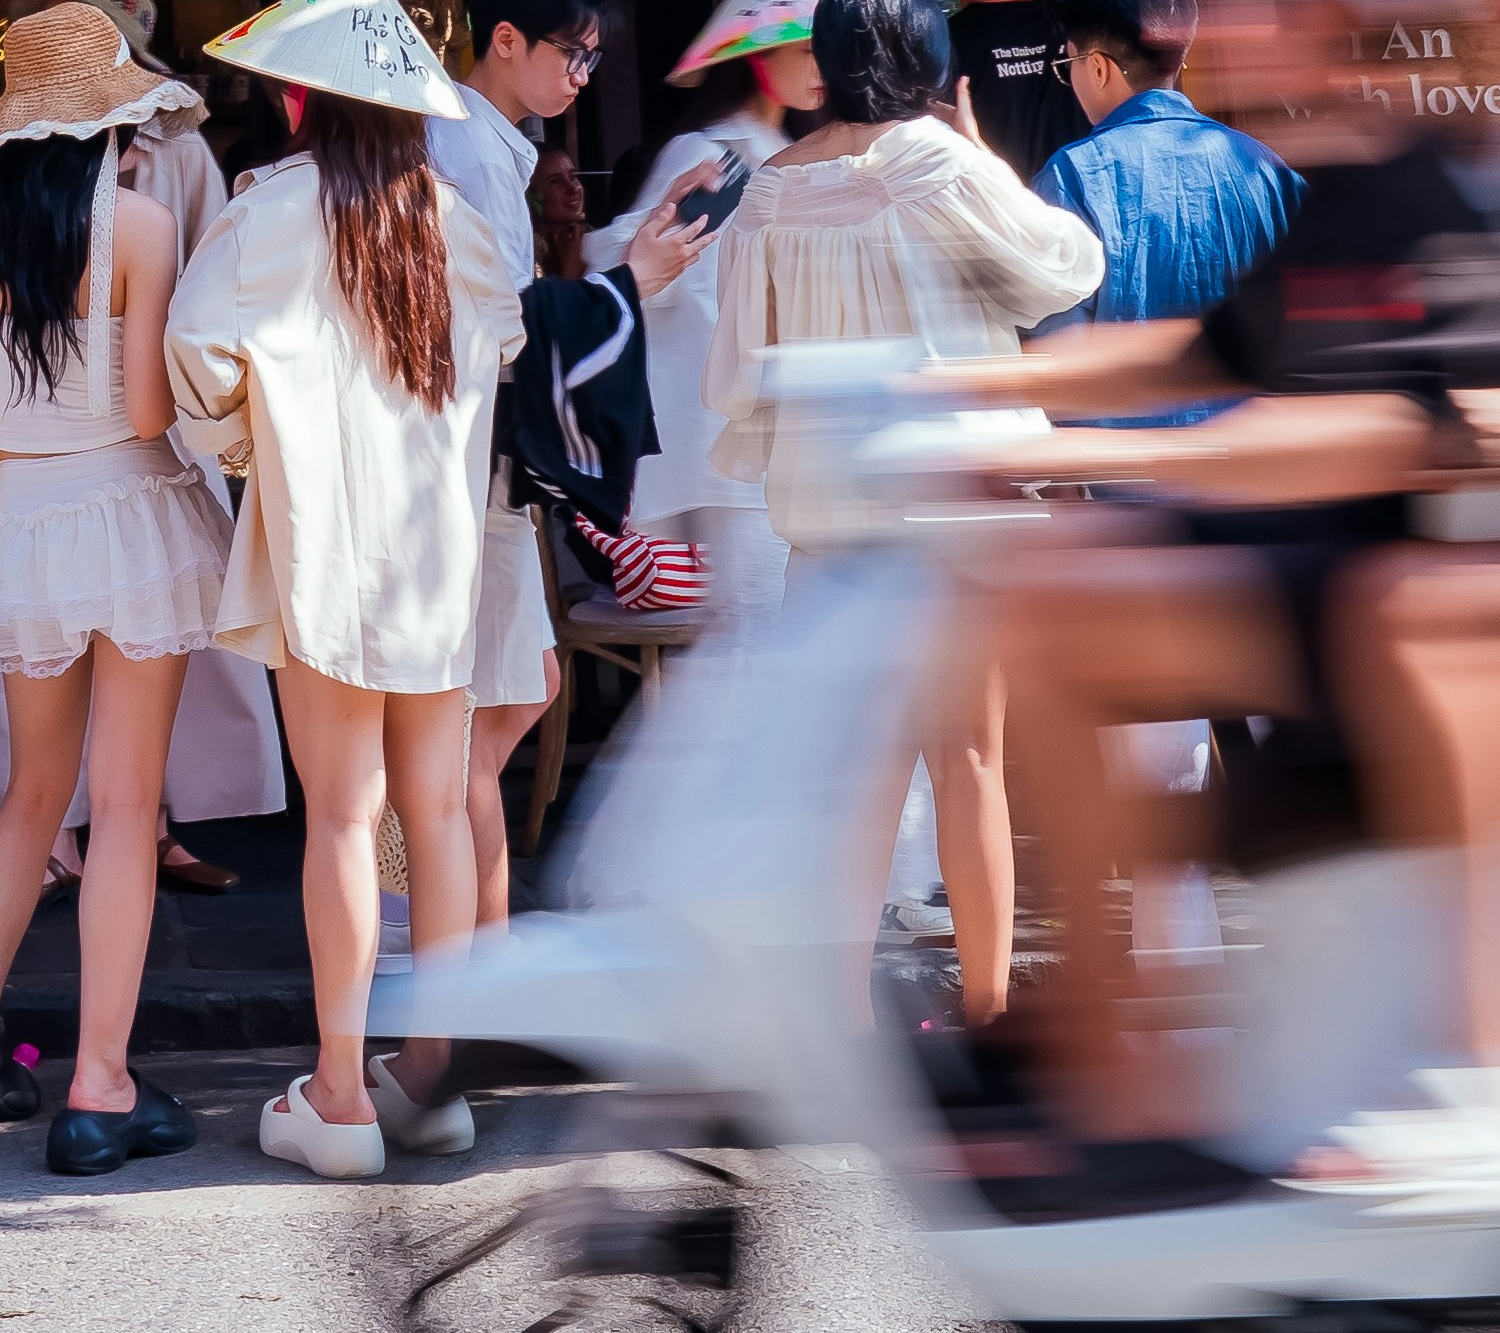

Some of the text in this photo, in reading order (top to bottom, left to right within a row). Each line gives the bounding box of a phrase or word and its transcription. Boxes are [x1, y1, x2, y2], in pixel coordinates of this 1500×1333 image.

[991, 47, 1012, 59] The
[1382, 20, 1455, 60] An
[399, 45, 430, 84] An
